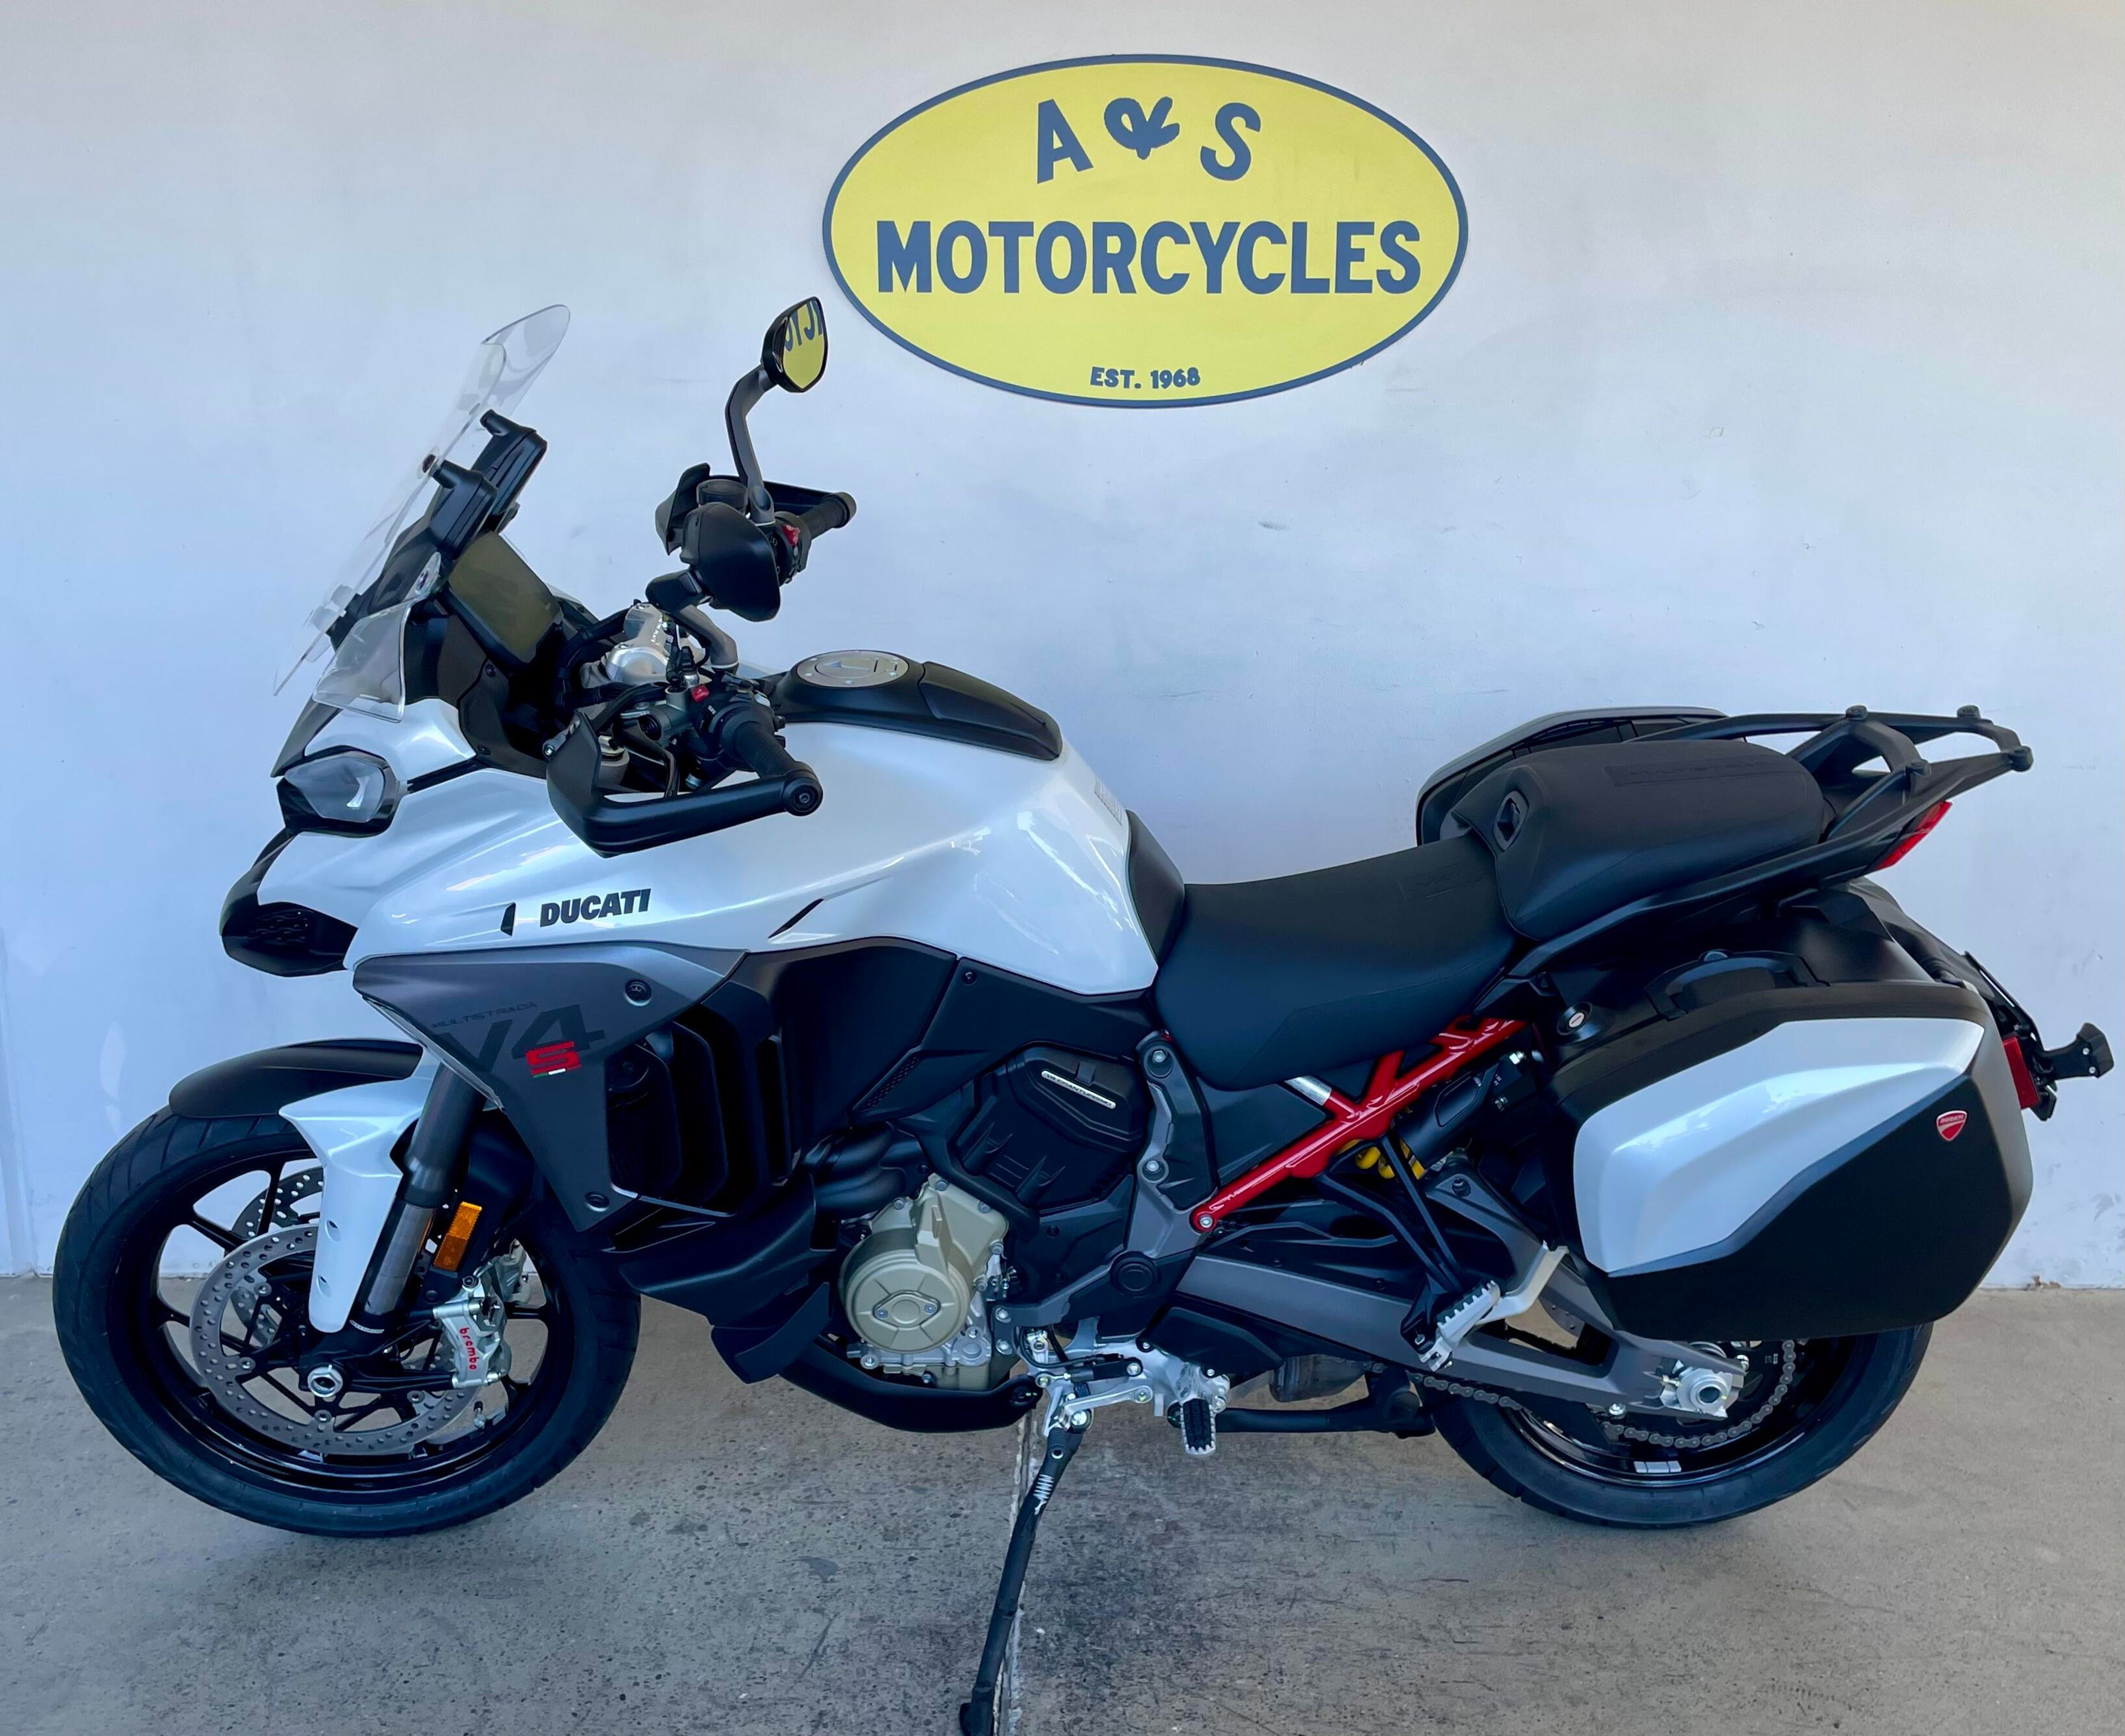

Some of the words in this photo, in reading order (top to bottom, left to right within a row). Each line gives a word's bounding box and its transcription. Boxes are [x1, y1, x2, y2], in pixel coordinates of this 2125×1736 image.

[1037, 99, 1093, 184] A
[1200, 102, 1261, 181] S
[877, 220, 1421, 294] MOTORCYCLES
[1090, 366, 1141, 388] EST.
[1150, 367, 1200, 388] 1968
[540, 888, 651, 927] DUCATI
[459, 1326, 480, 1370] brembo
